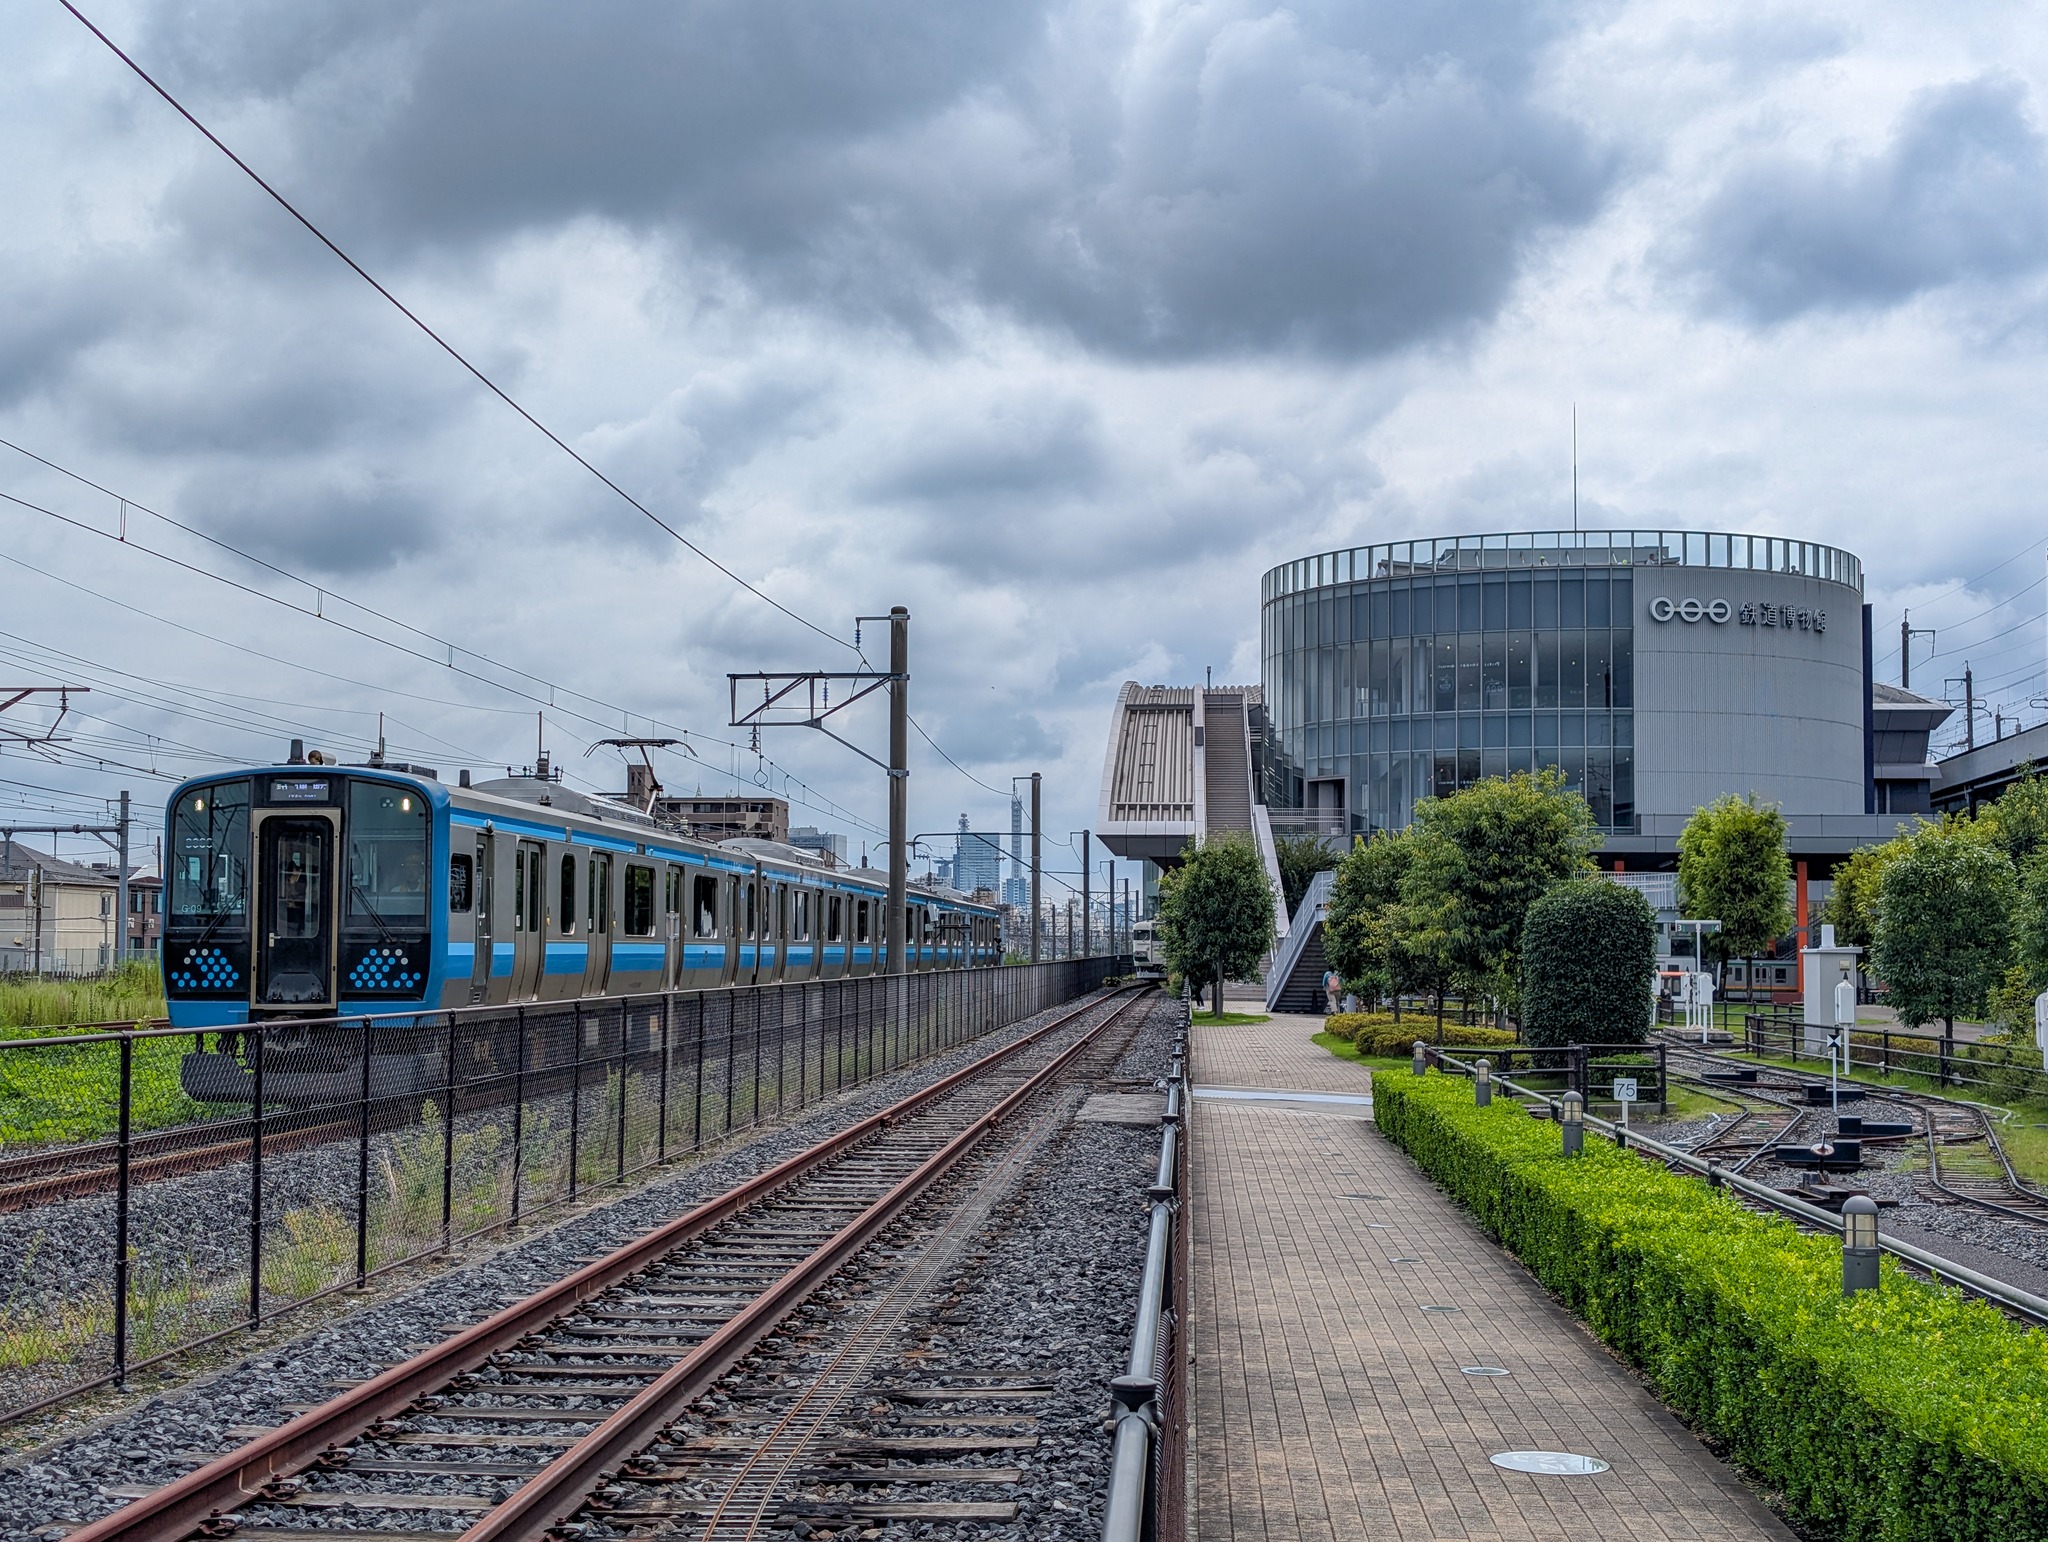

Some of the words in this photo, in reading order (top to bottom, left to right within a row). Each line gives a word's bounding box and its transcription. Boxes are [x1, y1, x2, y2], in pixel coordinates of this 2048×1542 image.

[1739, 601, 1827, 632] 鉄道博物館
[1616, 1083, 1636, 1097] 75
